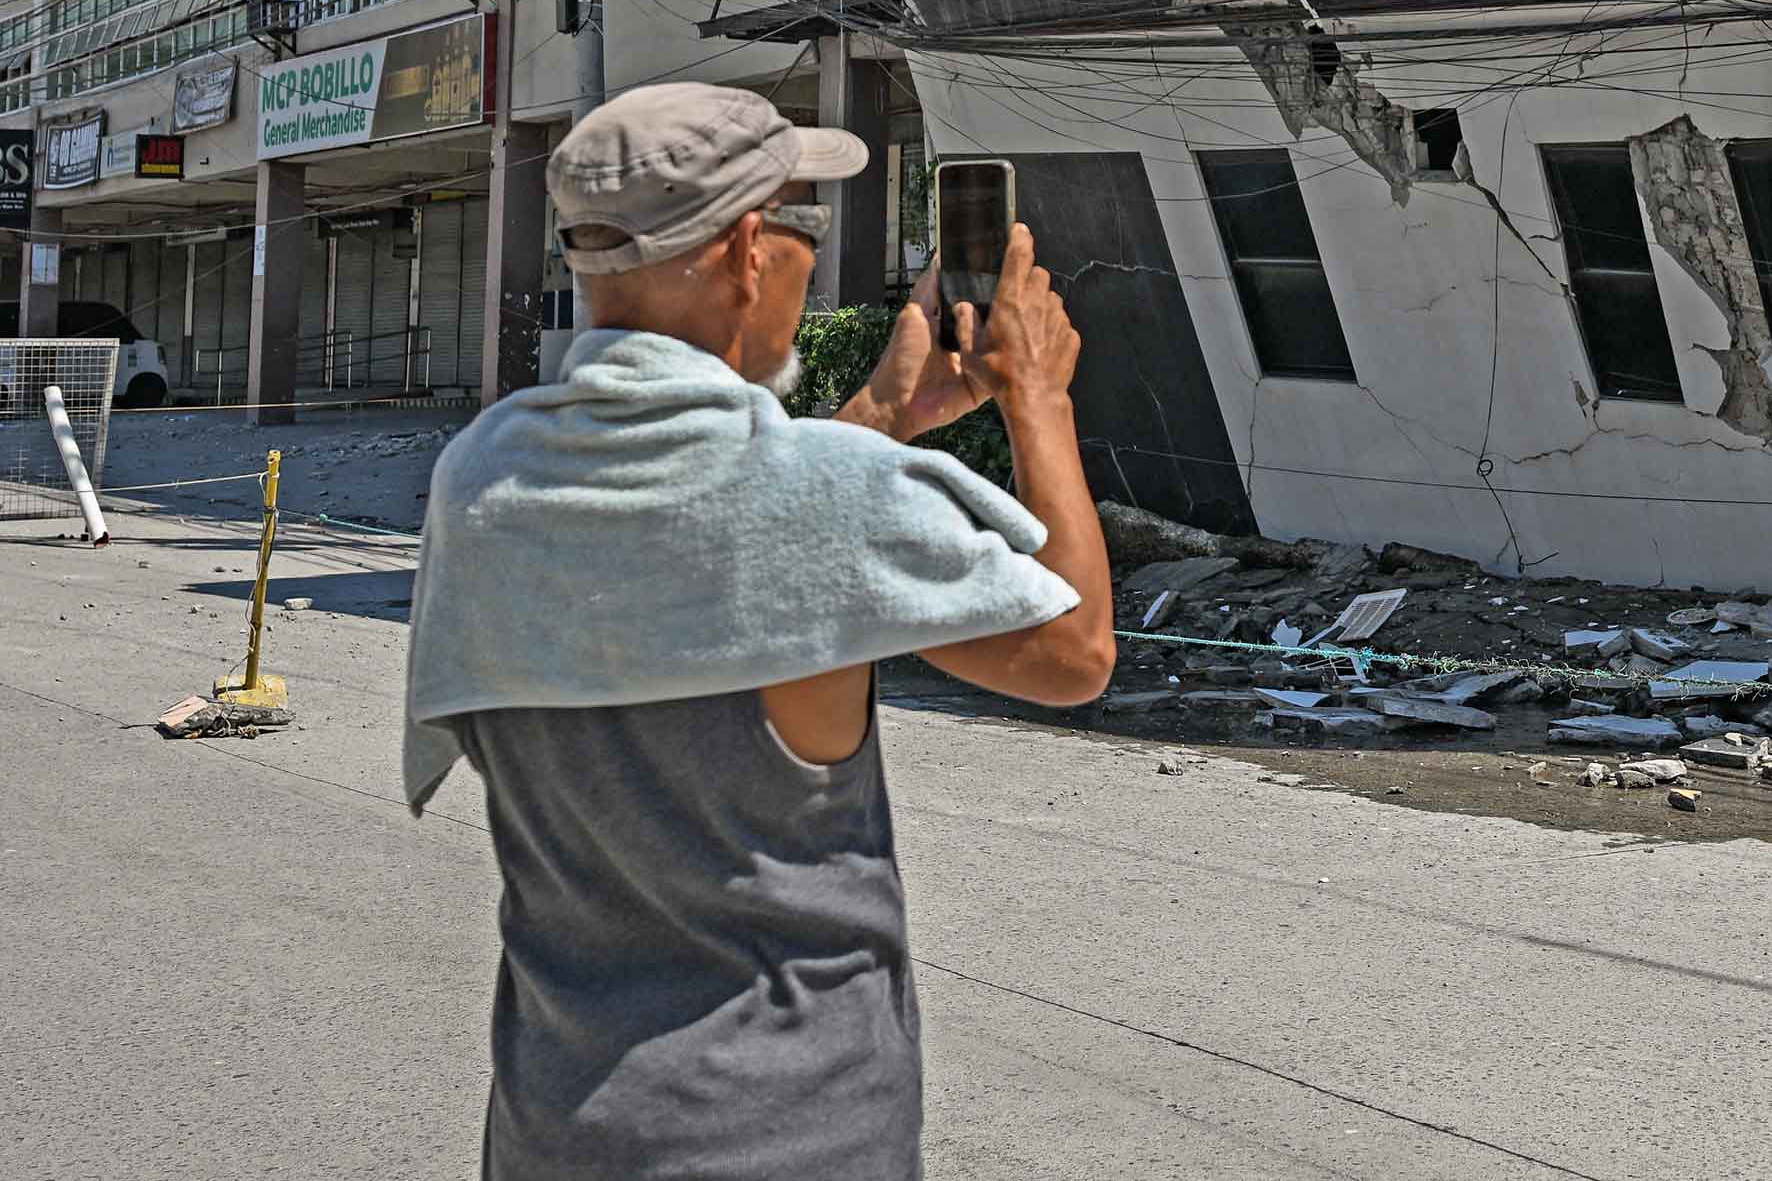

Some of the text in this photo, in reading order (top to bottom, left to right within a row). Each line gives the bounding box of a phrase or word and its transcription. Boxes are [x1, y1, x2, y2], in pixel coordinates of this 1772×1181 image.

[262, 70, 296, 113] MCP
[301, 52, 373, 106] BOBILLO
[264, 101, 366, 147] General Merchandise
[0, 143, 28, 185] S
